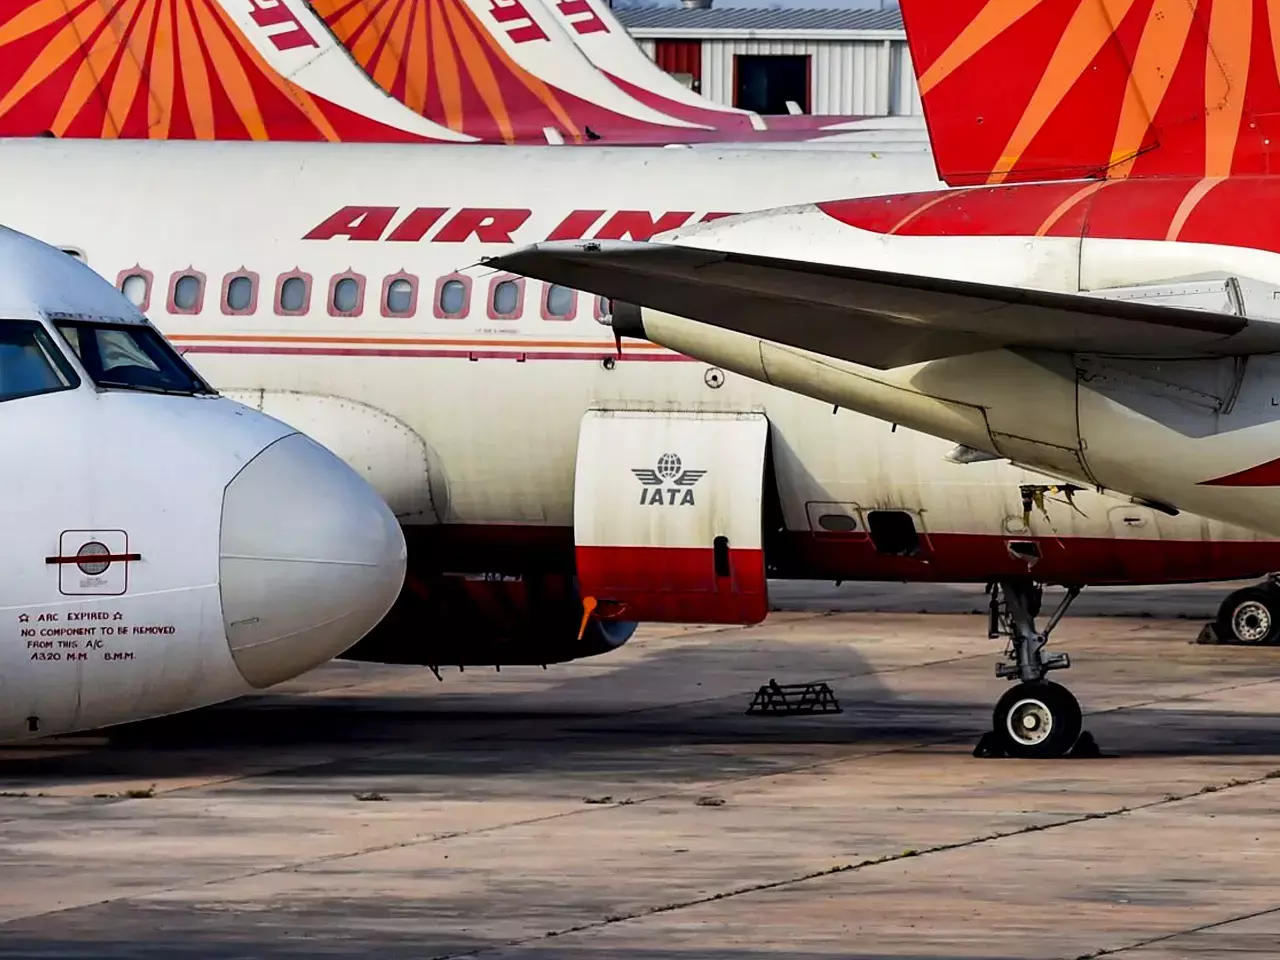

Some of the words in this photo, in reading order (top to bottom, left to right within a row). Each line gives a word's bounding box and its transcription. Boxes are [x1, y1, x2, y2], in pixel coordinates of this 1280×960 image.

[301, 206, 533, 244] AIR
[545, 209, 743, 242] IN
[639, 488, 696, 506] IATA
[37, 613, 59, 622] ARC
[67, 612, 110, 621] EXPIRED
[20, 628, 36, 637] NO
[40, 627, 97, 637] COMPONENT
[101, 627, 114, 635] TO
[117, 626, 129, 635] BE
[132, 626, 175, 635] REMOVED
[27, 640, 53, 649] FROM
[57, 640, 78, 648] THIS
[86, 640, 104, 650] A/C
[30, 652, 61, 661] A320
